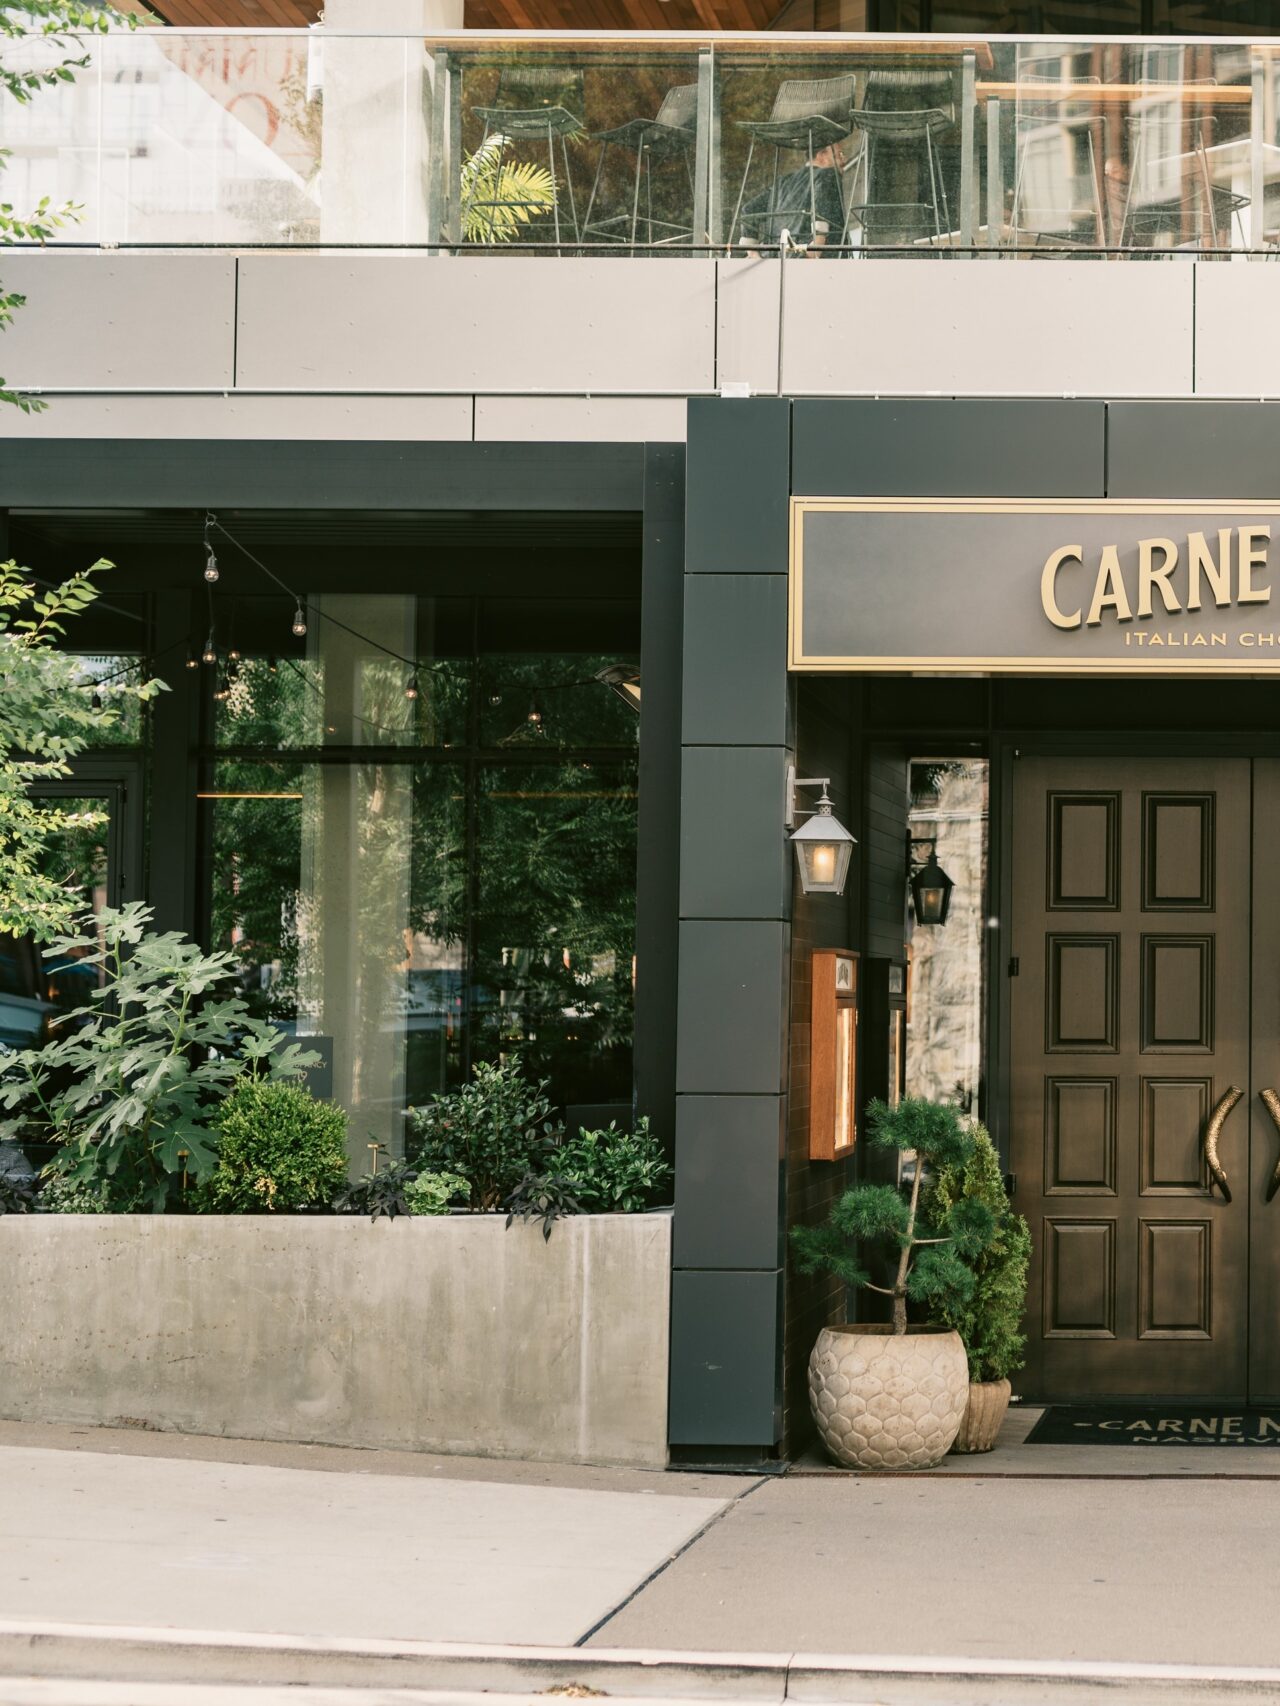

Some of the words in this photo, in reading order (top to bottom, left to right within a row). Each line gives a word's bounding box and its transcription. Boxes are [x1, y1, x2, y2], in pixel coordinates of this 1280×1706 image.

[1040, 524, 1272, 630] CARNE
[1124, 631, 1228, 646] ITALIAN
[1098, 1416, 1244, 1437] CARNE
